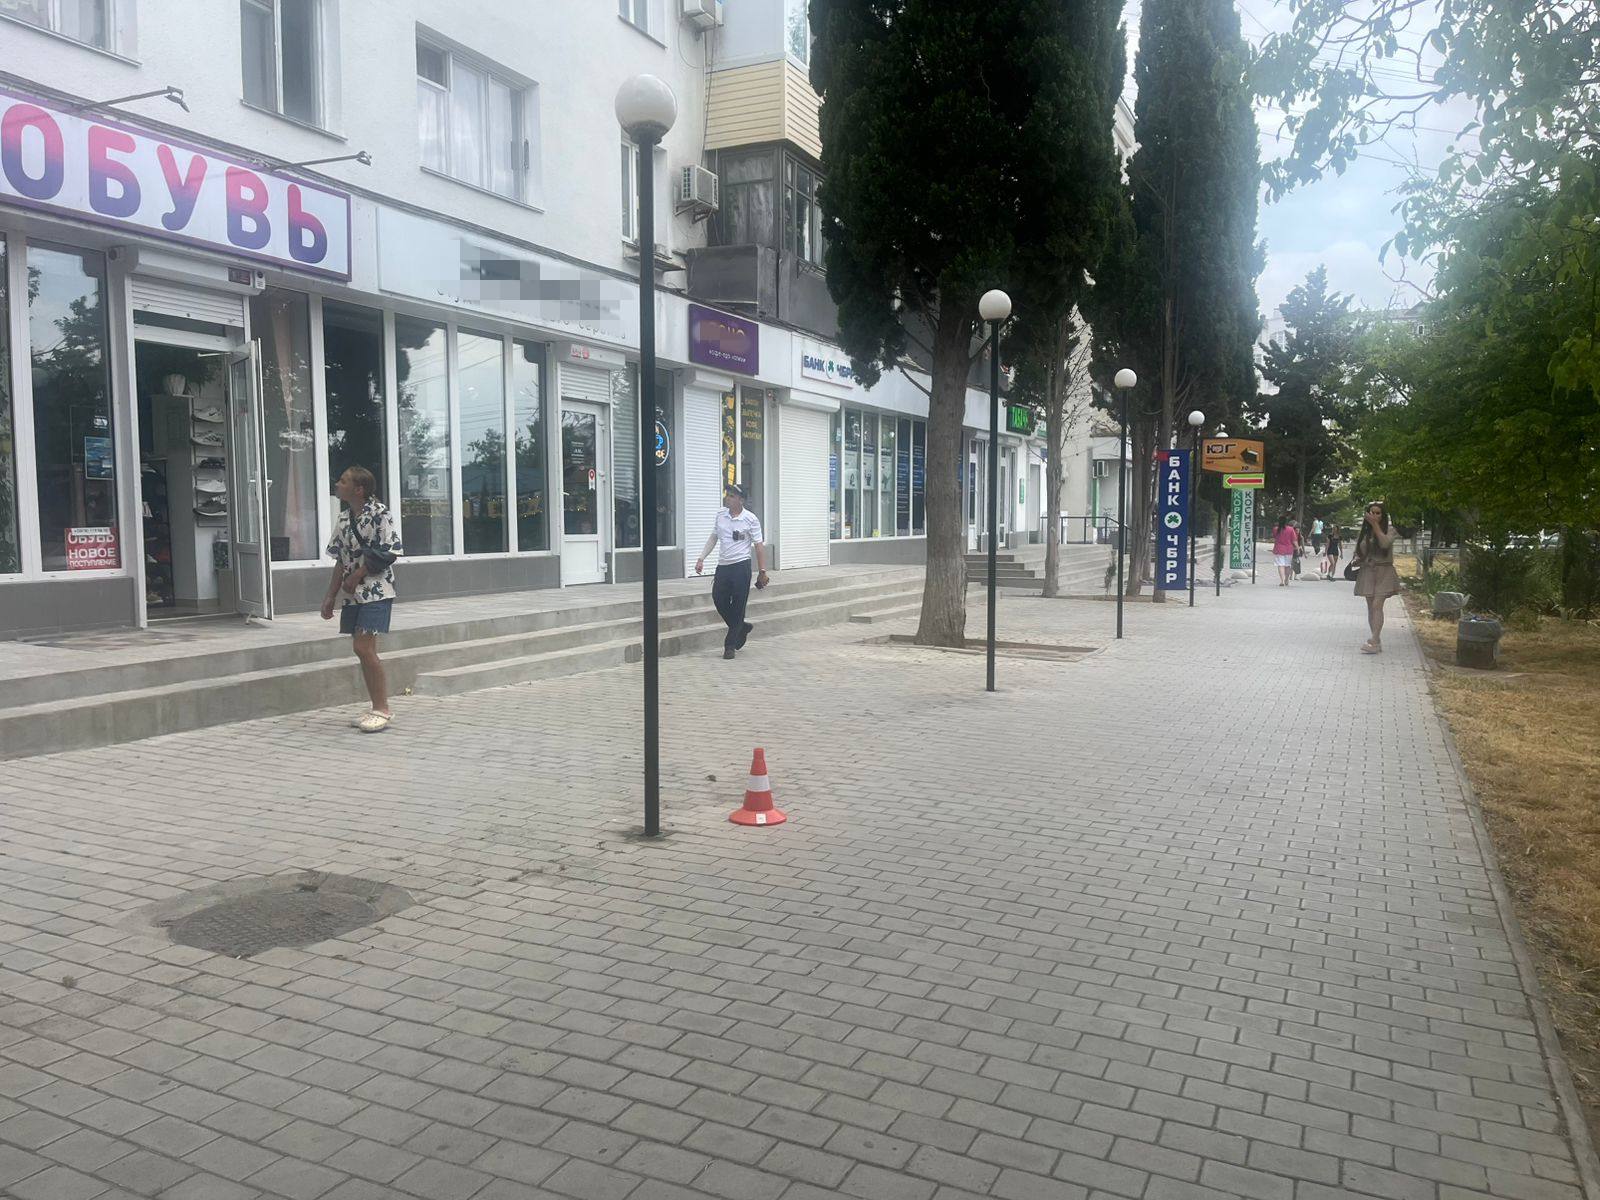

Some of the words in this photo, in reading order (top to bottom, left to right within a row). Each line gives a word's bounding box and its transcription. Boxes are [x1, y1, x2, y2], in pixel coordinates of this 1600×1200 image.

[1, 103, 328, 264] ОБУВЬ
[804, 355, 825, 372] БАНК
[1168, 457, 1180, 506] БАНК
[1244, 492, 1252, 560] КОСМЕТИКА
[69, 547, 116, 559] НОВОЕ
[1166, 535, 1179, 583] ЧБРР
